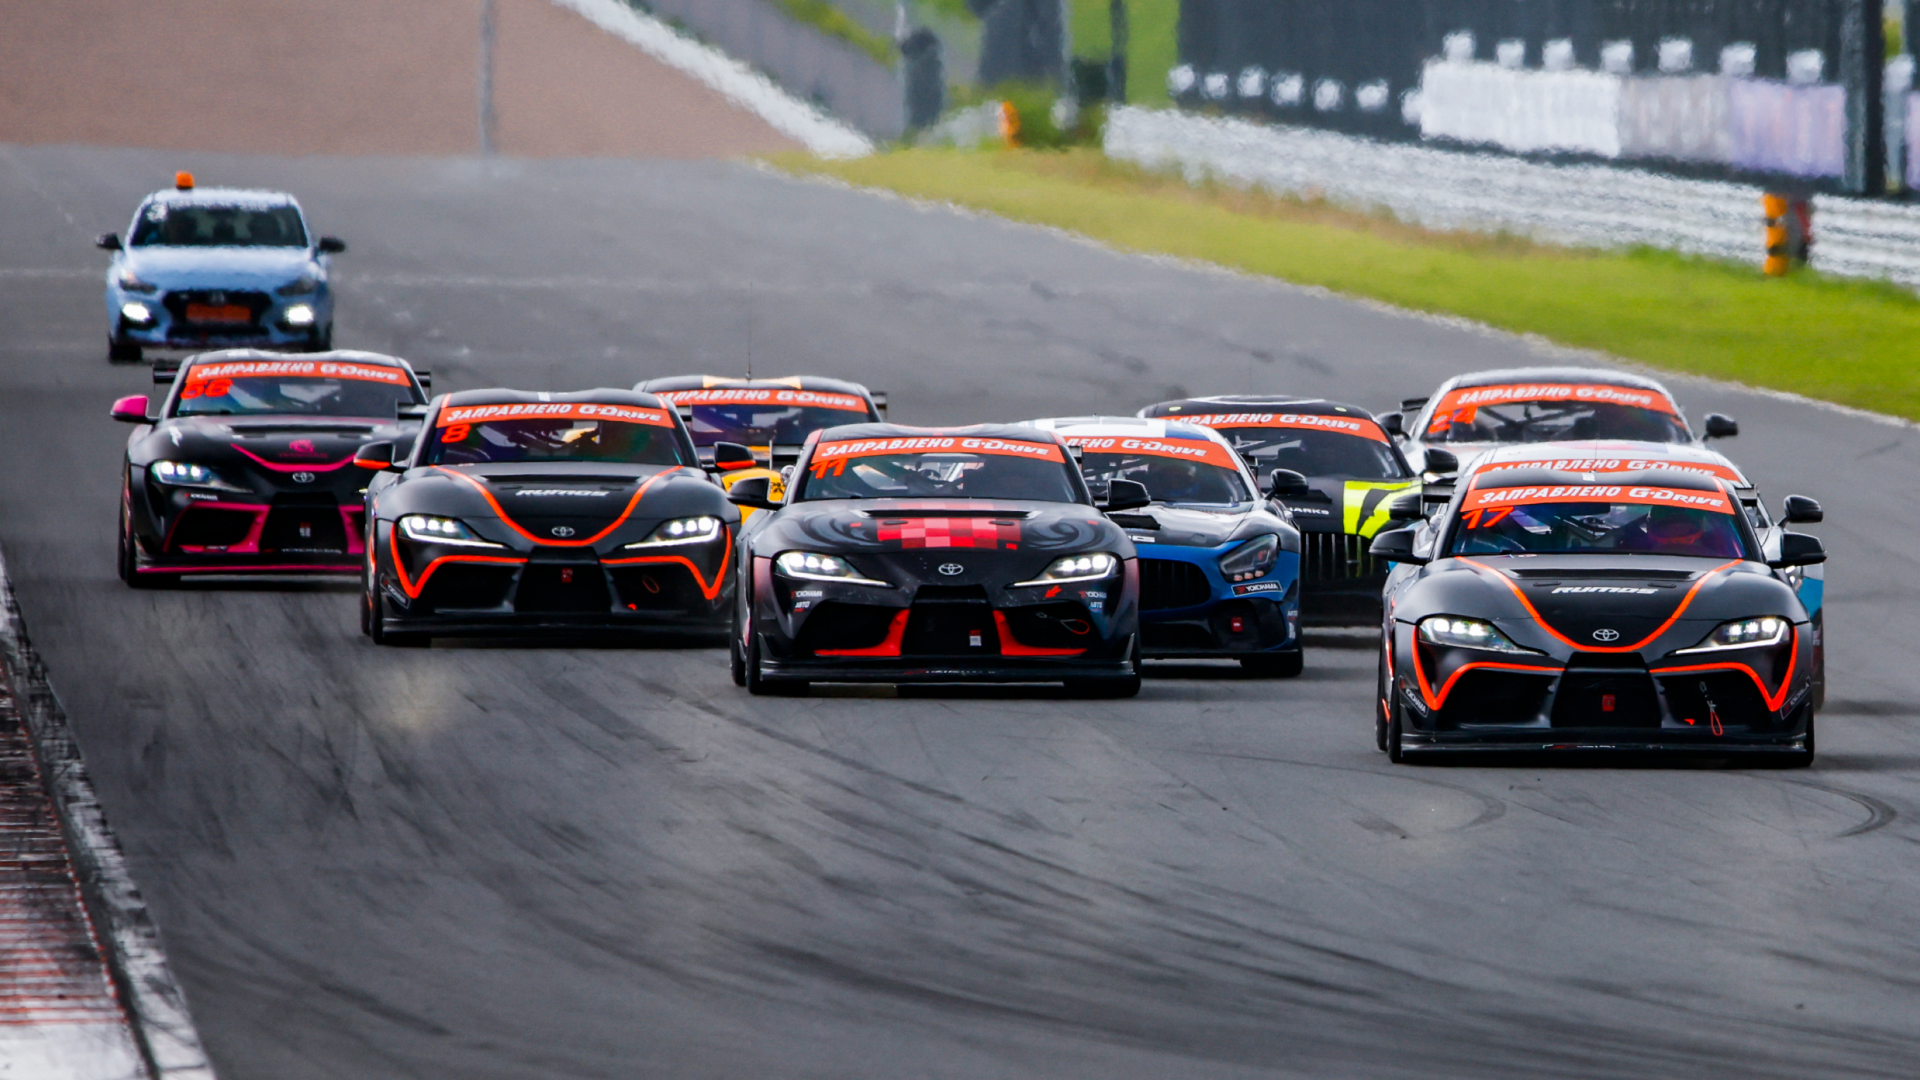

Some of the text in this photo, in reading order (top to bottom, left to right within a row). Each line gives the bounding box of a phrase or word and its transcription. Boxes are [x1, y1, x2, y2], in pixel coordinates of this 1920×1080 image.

[197, 361, 315, 378] ЗАПРАВЛЕНО
[660, 389, 771, 402] АПРАВЛЕНО
[1456, 385, 1572, 405] ЗАПРАВЛЕНО
[446, 403, 573, 422] ЗАПРАВЛЕНО
[440, 423, 471, 443] 8
[821, 438, 955, 457] ЗАПРАВЛЕНО
[809, 458, 848, 479] 11
[515, 489, 610, 497] RUMOS
[1478, 486, 1622, 504] ЗАПРАВЛЕНО
[1461, 506, 1514, 530] 17
[1245, 582, 1279, 592] YOKOHAMA
[1551, 586, 1659, 595] RUMOS
